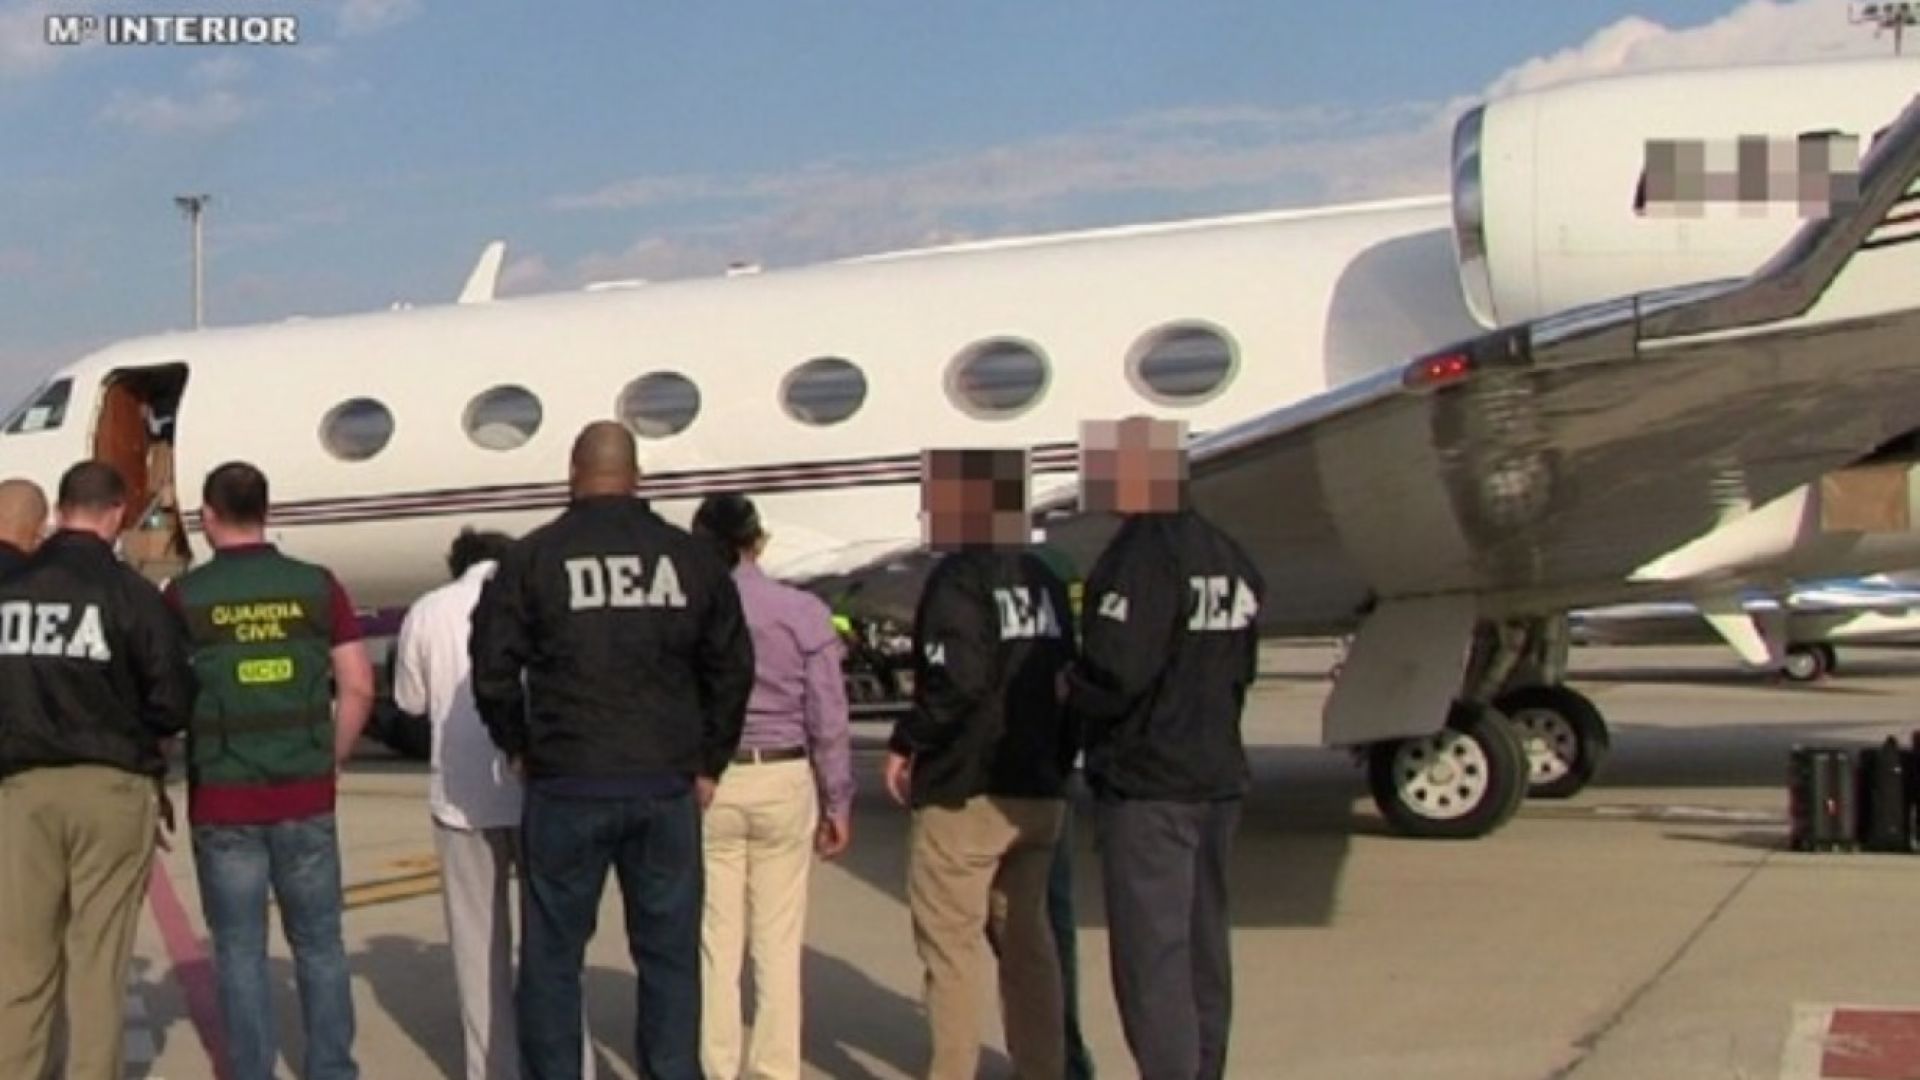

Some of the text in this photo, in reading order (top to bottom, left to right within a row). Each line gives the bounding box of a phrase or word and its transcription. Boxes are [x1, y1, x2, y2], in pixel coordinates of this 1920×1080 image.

[564, 555, 687, 610] DEA
[0, 601, 111, 660] DEA
[211, 602, 304, 625] GUARDIA
[235, 621, 288, 642] CIVIL
[993, 587, 1061, 639] DEA
